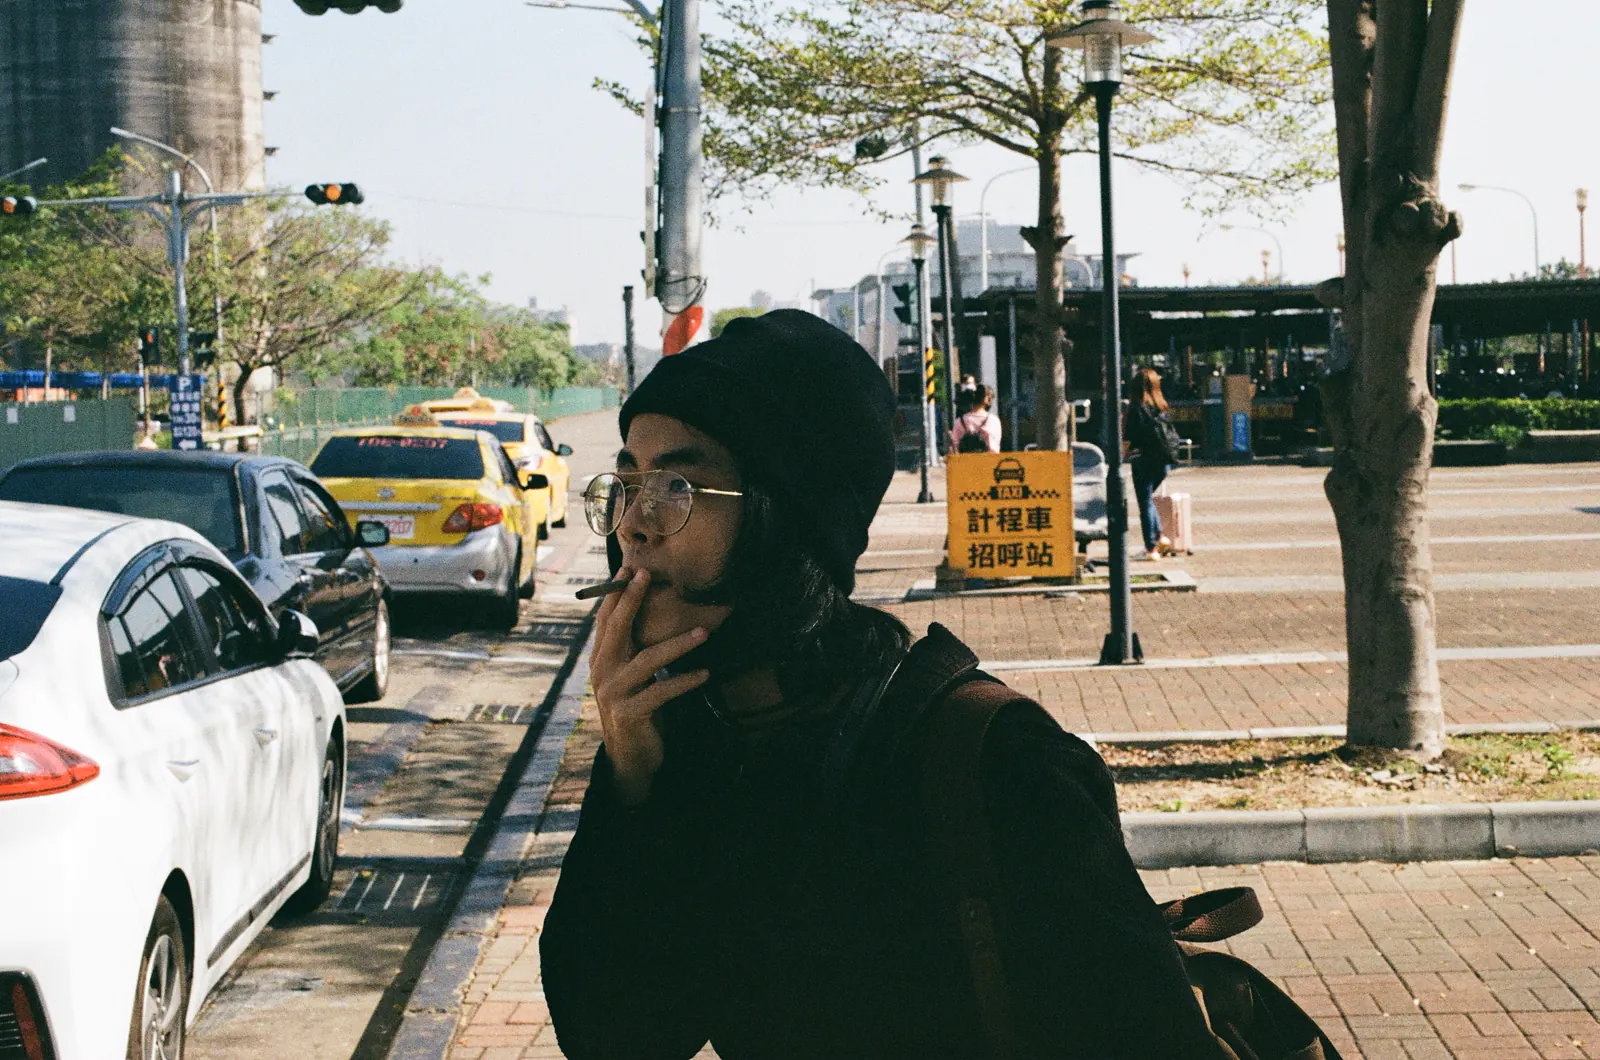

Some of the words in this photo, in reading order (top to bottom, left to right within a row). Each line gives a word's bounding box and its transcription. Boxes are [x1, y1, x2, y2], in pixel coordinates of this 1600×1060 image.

[178, 376, 191, 391] P
[997, 485, 1023, 500] TAXI
[966, 506, 1053, 533] 計程車
[968, 541, 1054, 568] 招呼站
